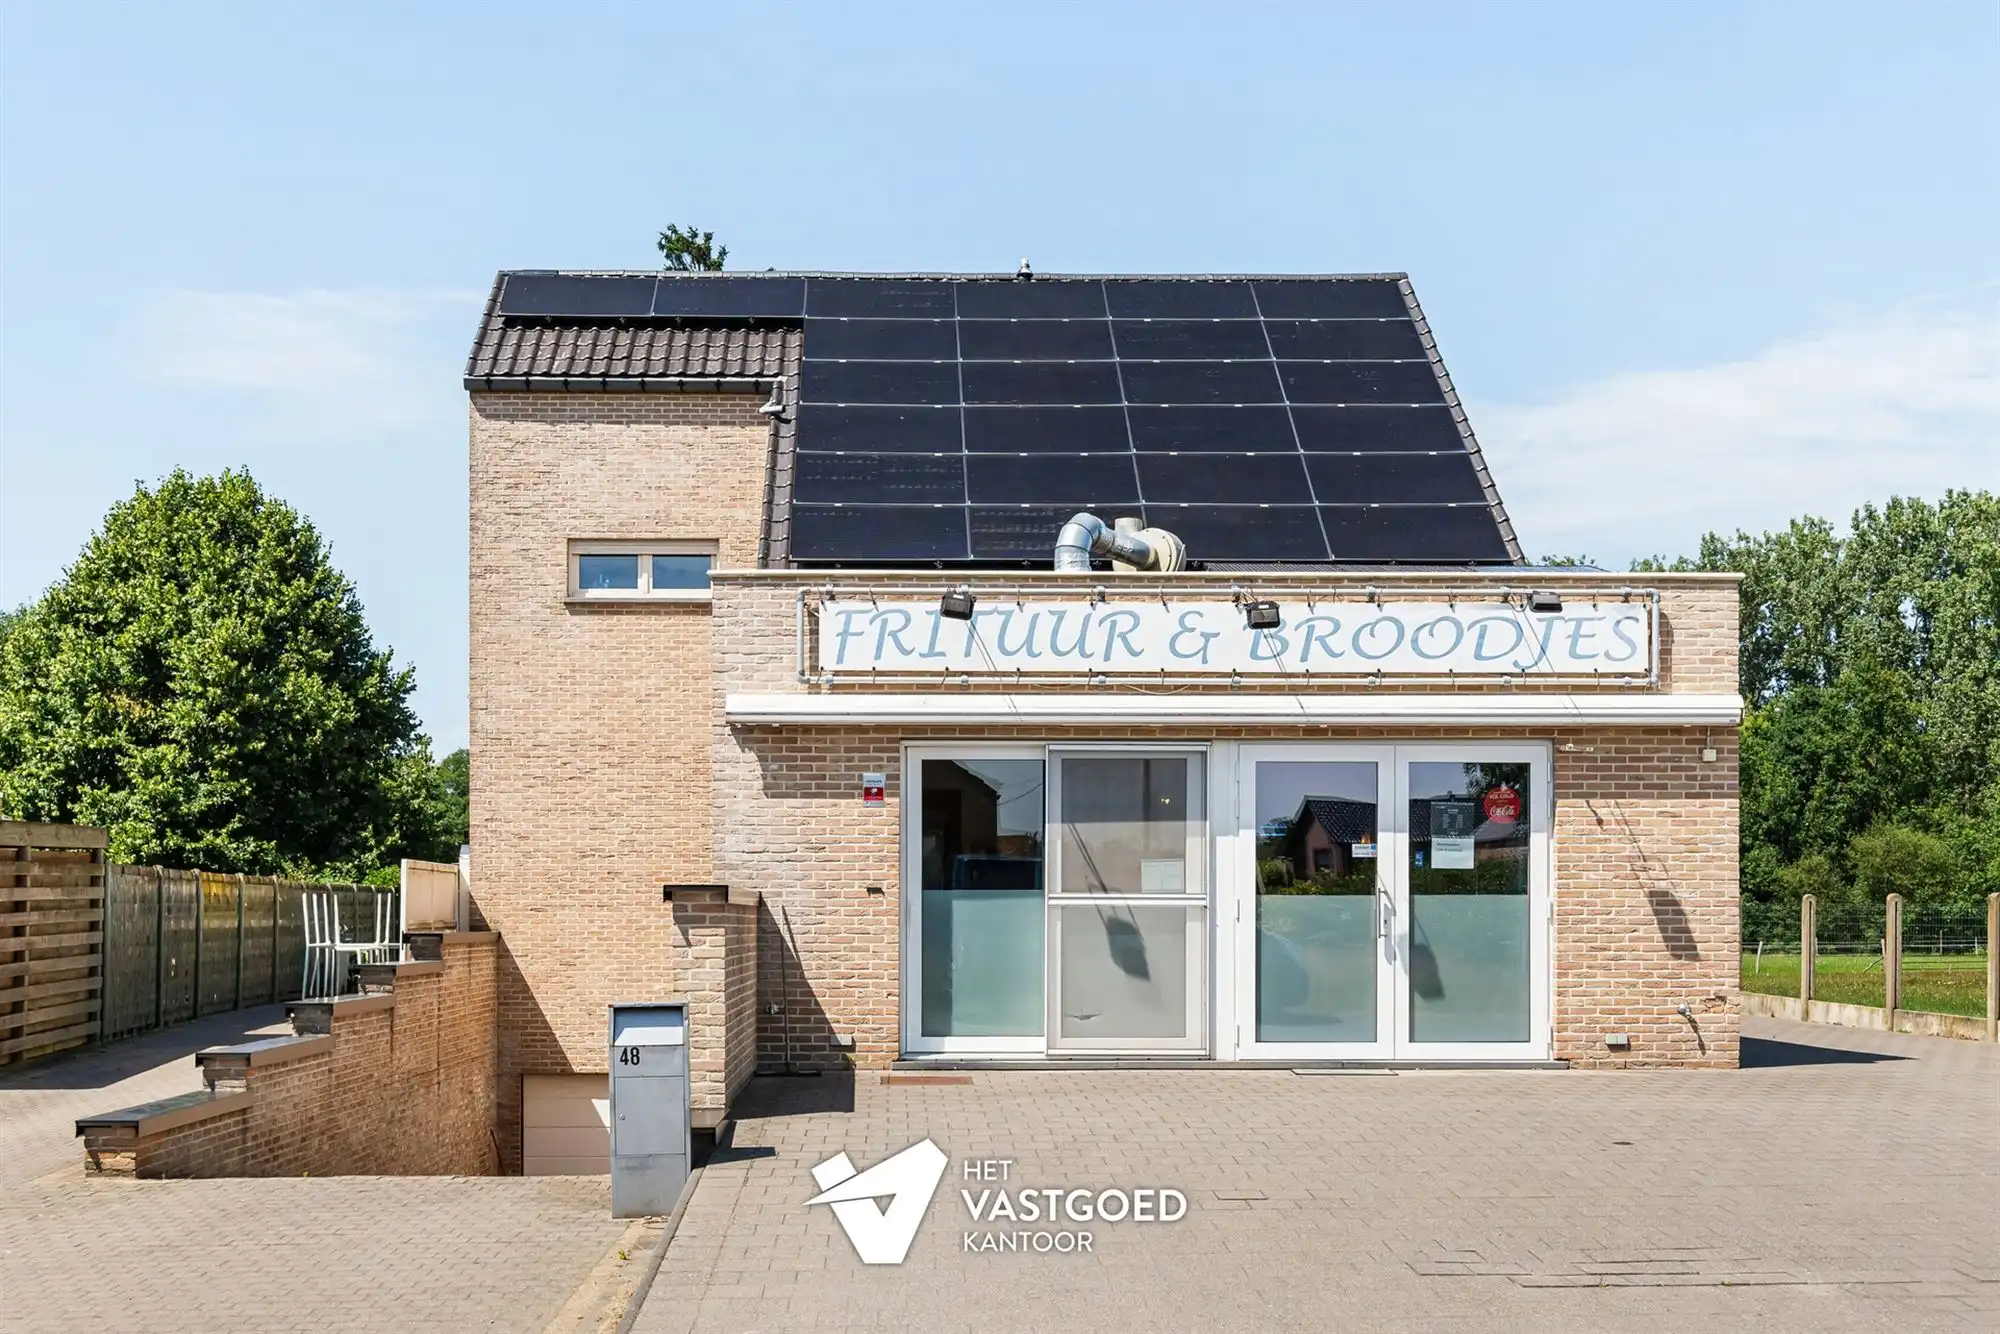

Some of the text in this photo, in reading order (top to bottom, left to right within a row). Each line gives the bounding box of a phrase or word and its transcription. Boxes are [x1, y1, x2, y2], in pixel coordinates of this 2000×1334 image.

[835, 608, 1640, 670] FRITUUR & BROODJES
[619, 1047, 640, 1066] 48
